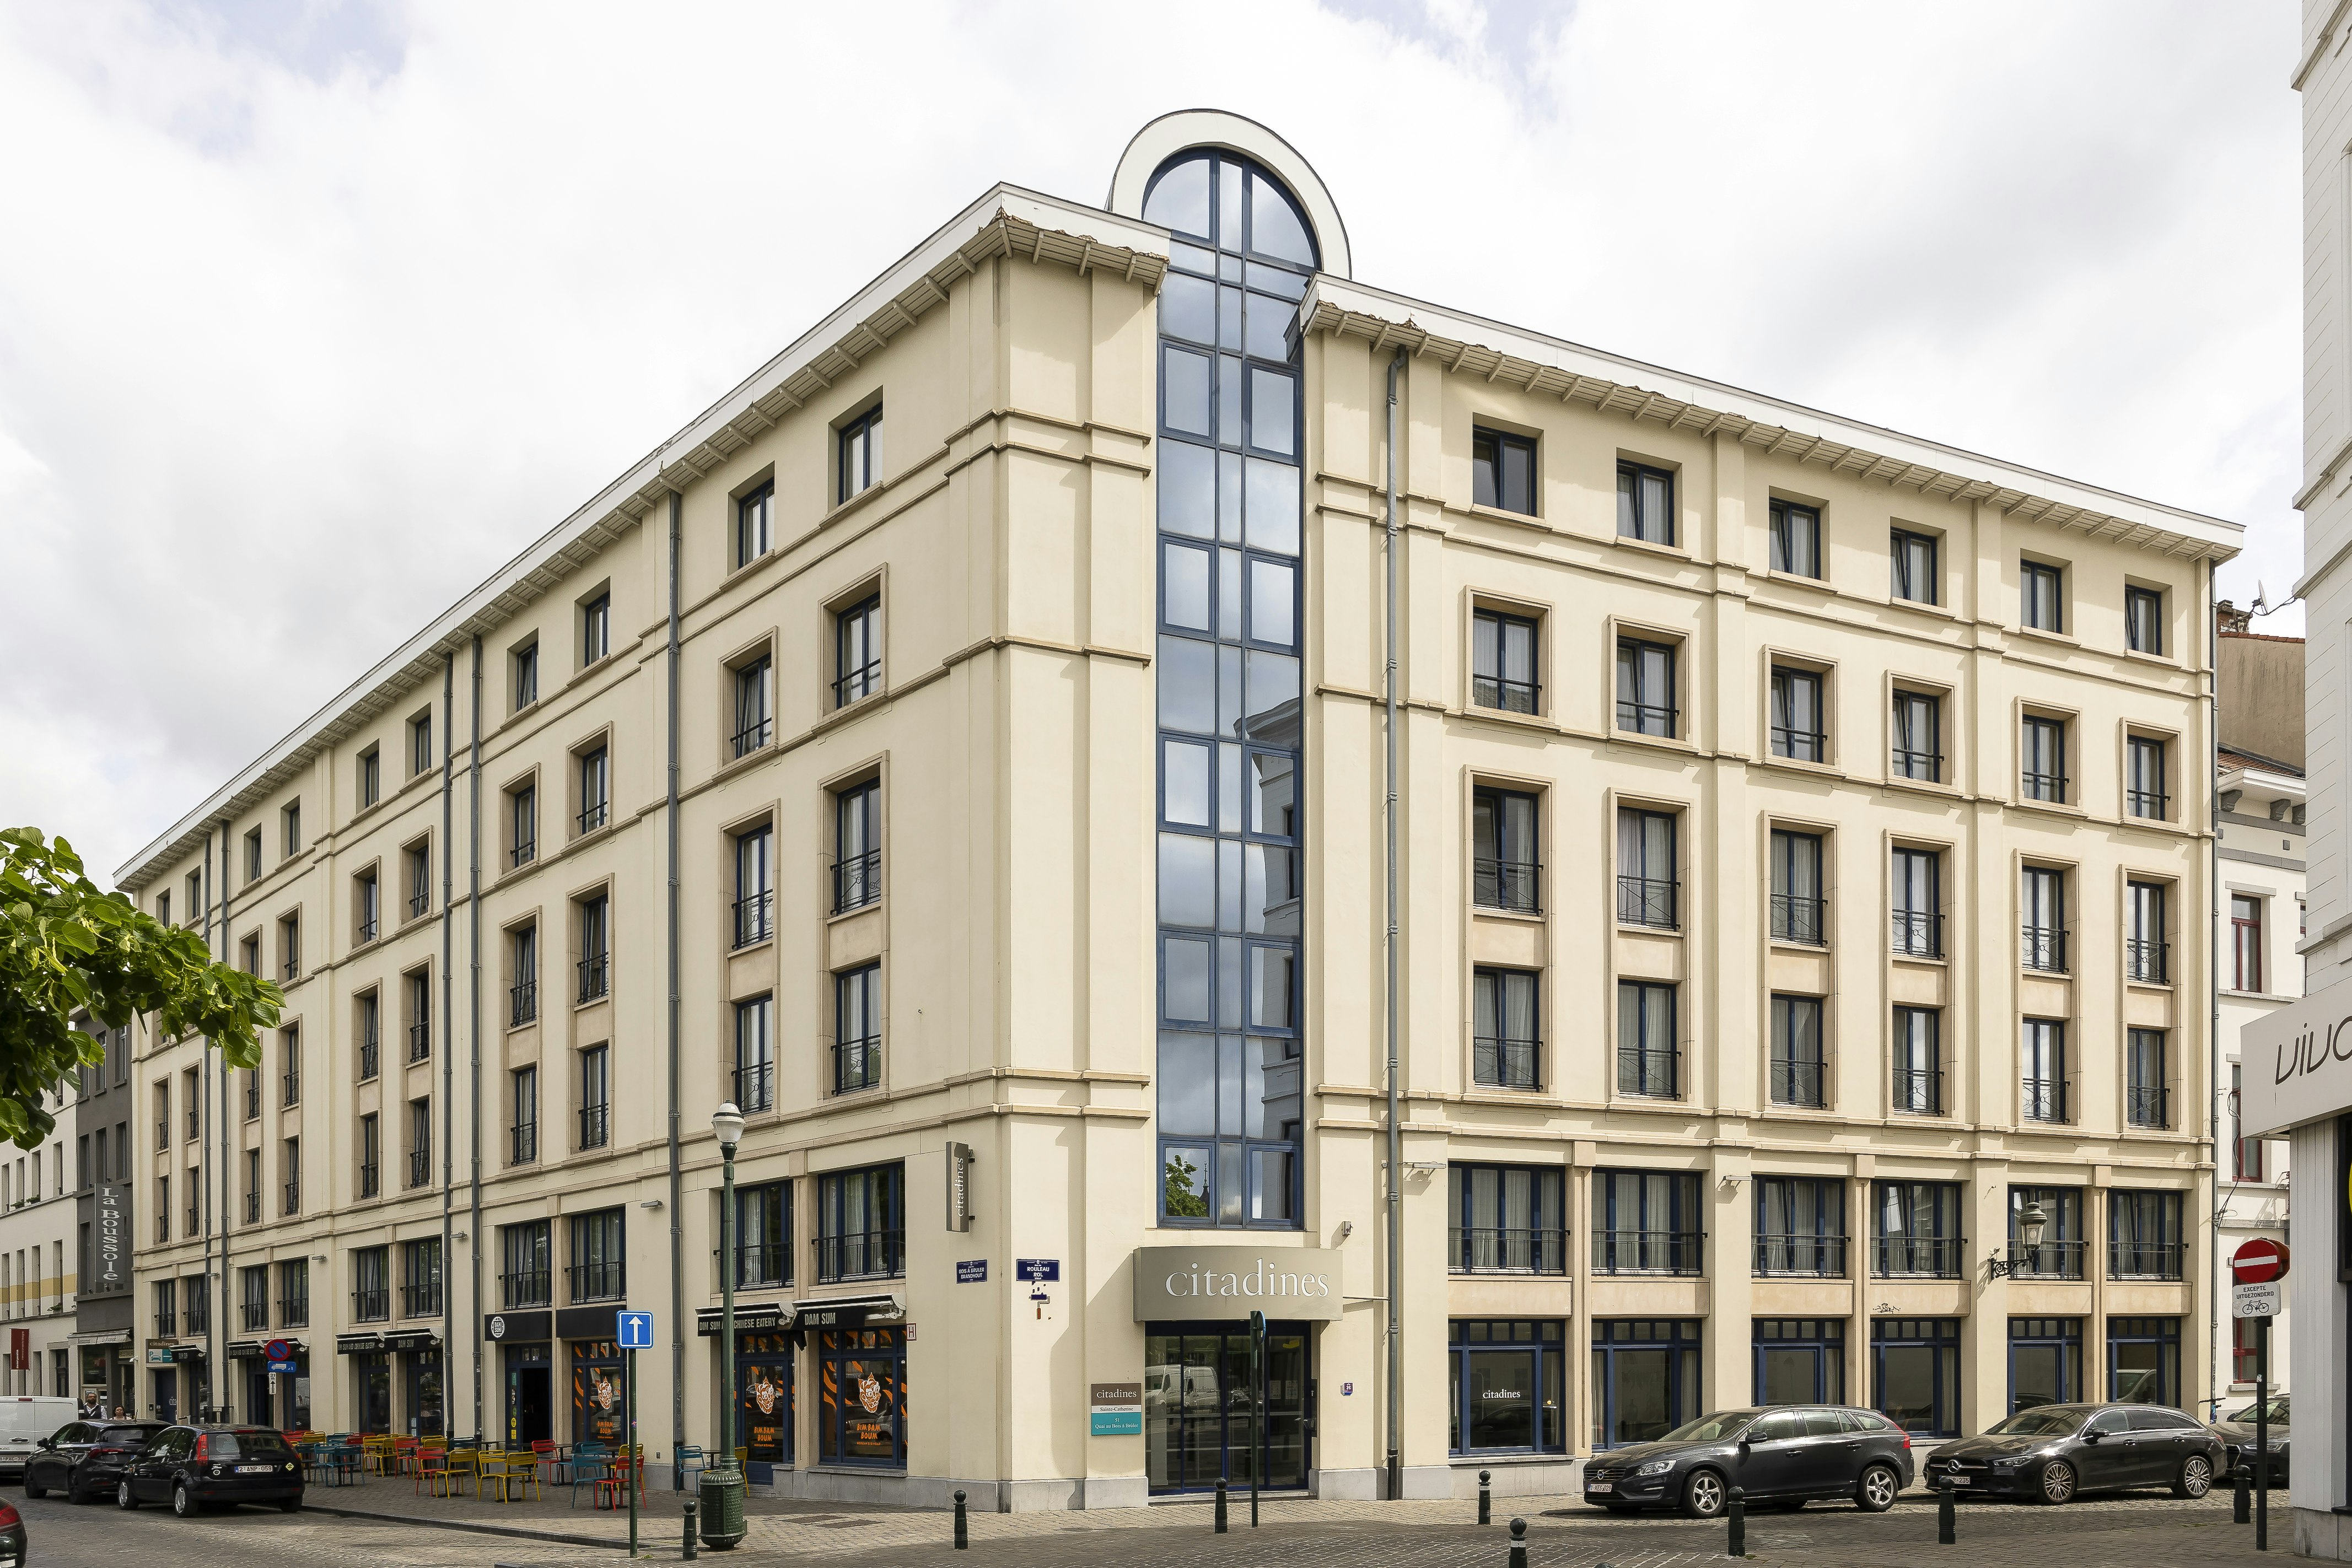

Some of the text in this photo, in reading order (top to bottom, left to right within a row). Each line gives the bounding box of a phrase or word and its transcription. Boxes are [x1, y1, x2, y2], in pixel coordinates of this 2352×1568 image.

[955, 1157, 964, 1217] citadines
[100, 1187, 120, 1280] La Boussole
[1165, 1257, 1328, 1297] citadines
[699, 1322, 709, 1330] DIM
[710, 1321, 720, 1330] SUM
[734, 1318, 755, 1329] CHINESE
[756, 1317, 776, 1328] EATERY
[805, 1312, 836, 1325] DAM SUM
[1096, 1389, 1137, 1398] citadines
[1483, 1389, 1521, 1398] citadines
